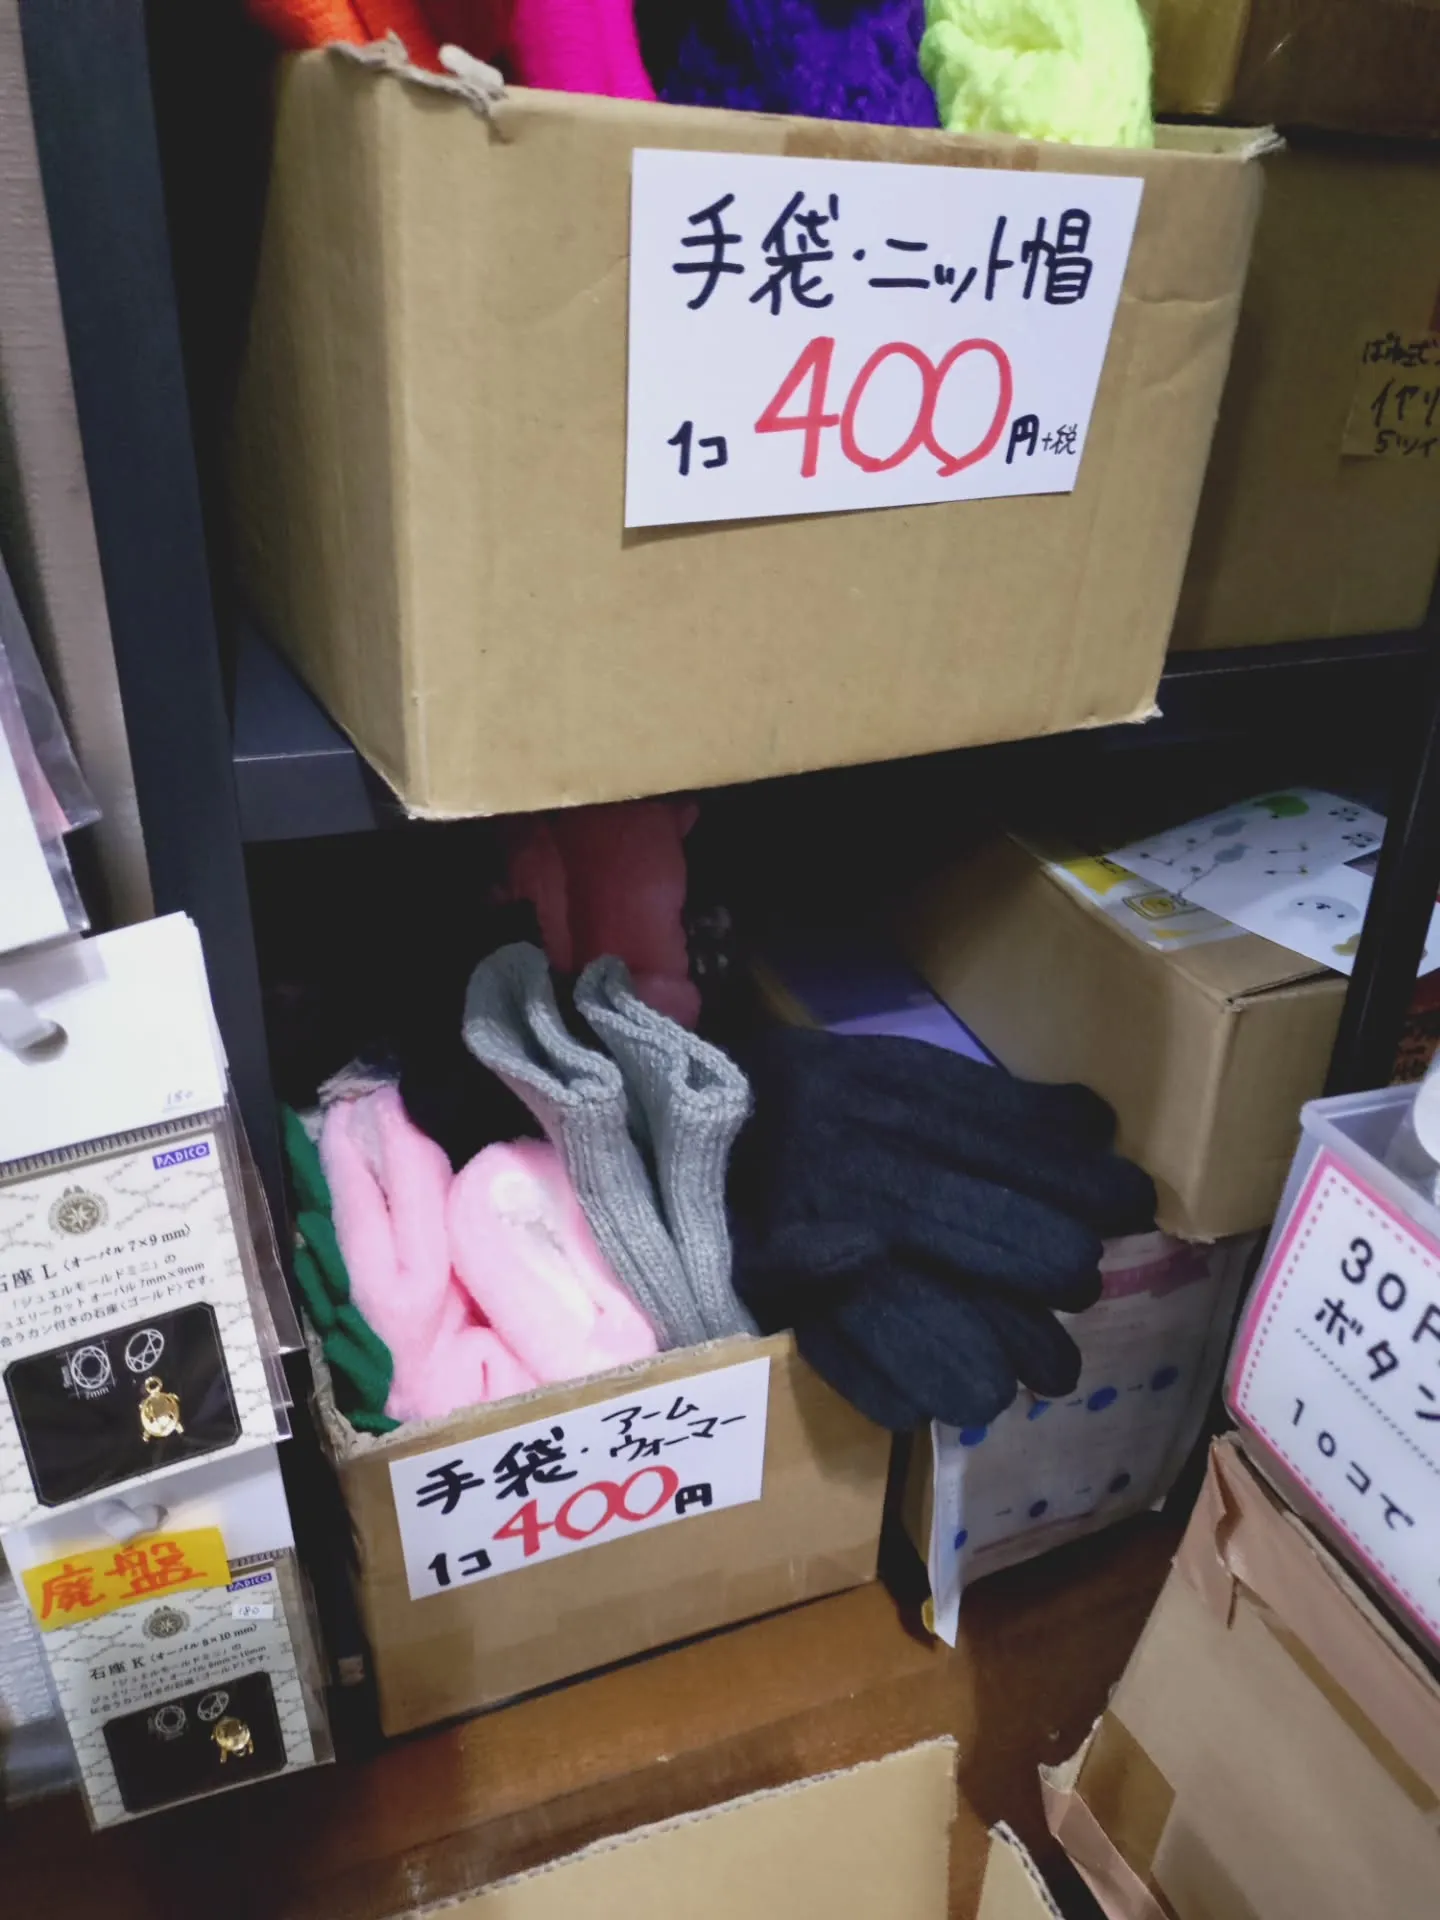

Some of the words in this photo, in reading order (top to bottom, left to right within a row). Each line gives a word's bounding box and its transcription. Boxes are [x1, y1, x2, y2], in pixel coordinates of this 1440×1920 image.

[672, 191, 1093, 315] 手袋・ニット帽
[668, 420, 728, 476] 1コ
[154, 1143, 209, 1168] PADICO
[41, 1264, 57, 1280] L
[602, 1396, 699, 1436] アーム
[608, 1414, 747, 1462] ウォーマー
[428, 1549, 492, 1587] 1コ
